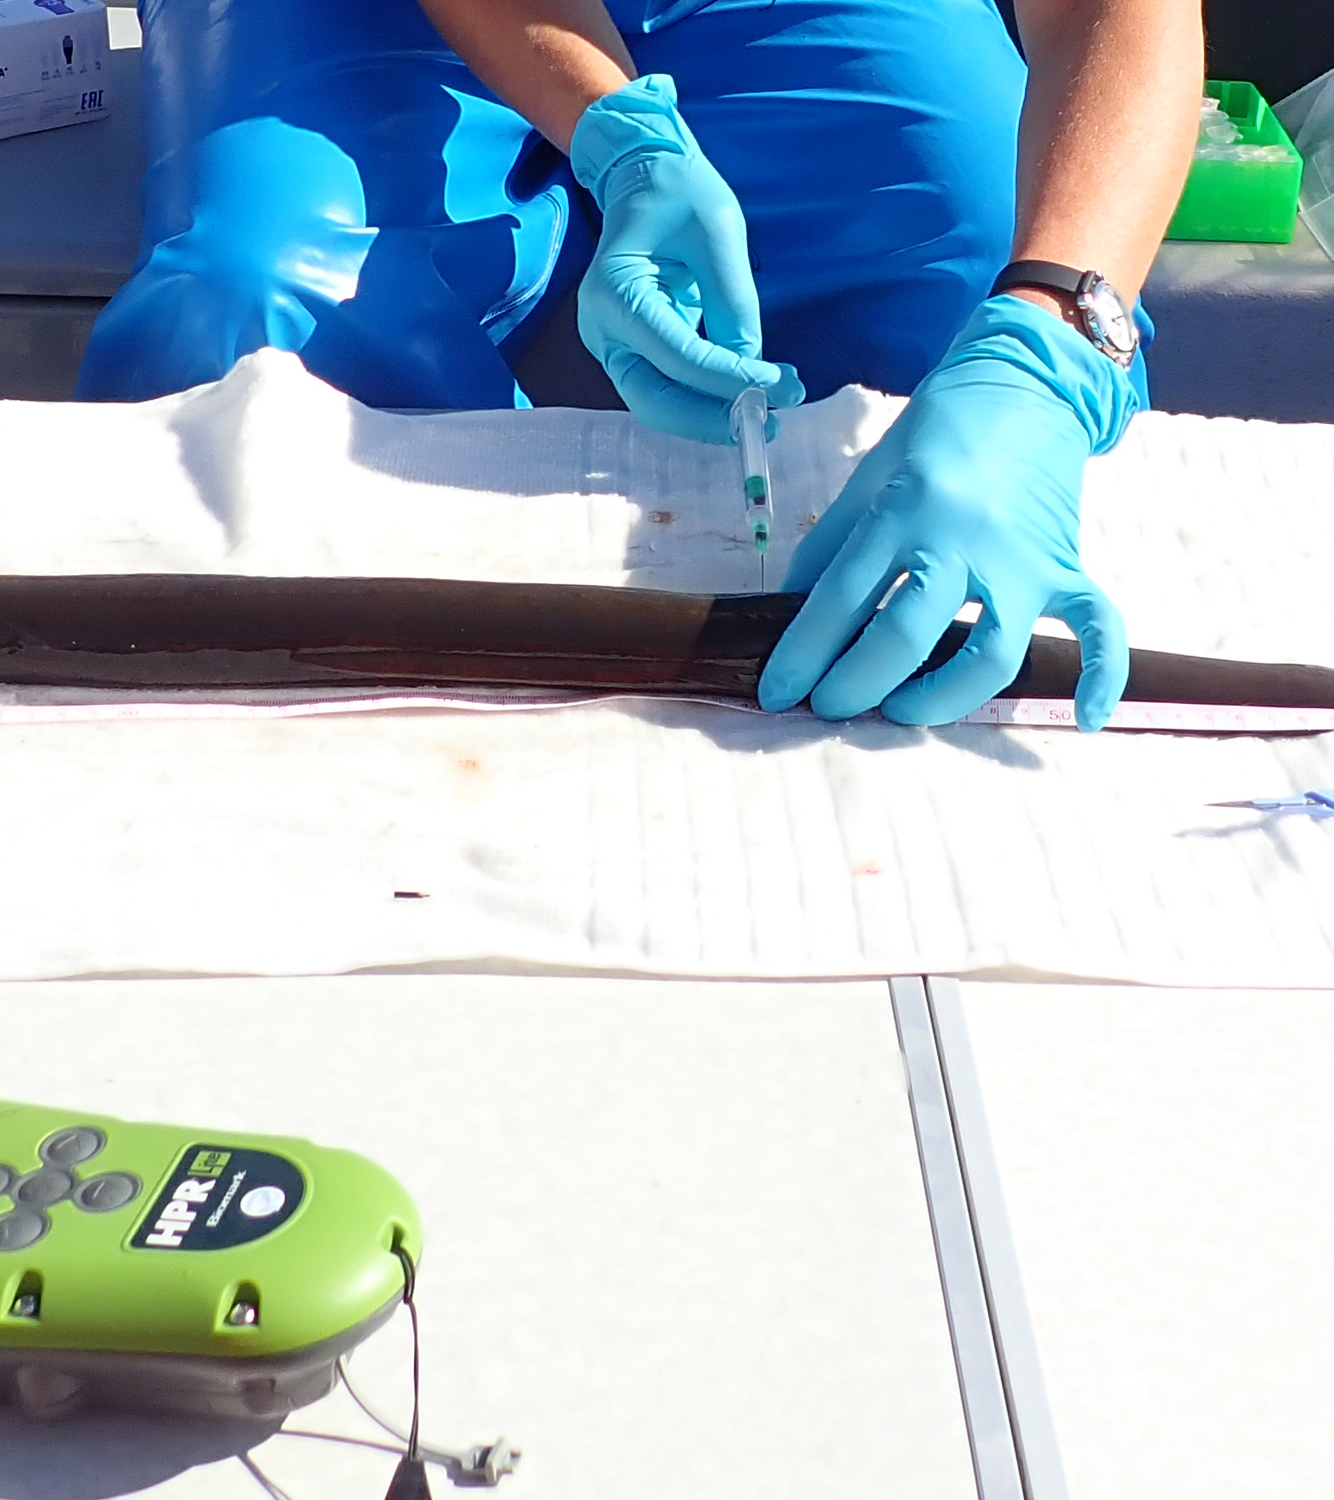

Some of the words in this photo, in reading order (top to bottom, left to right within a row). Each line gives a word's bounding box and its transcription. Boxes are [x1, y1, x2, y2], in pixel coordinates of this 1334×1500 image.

[1049, 709, 1072, 721] 50
[145, 1177, 217, 1246] HPR
[188, 1150, 232, 1178] Lite
[205, 1169, 248, 1227] Biomark
